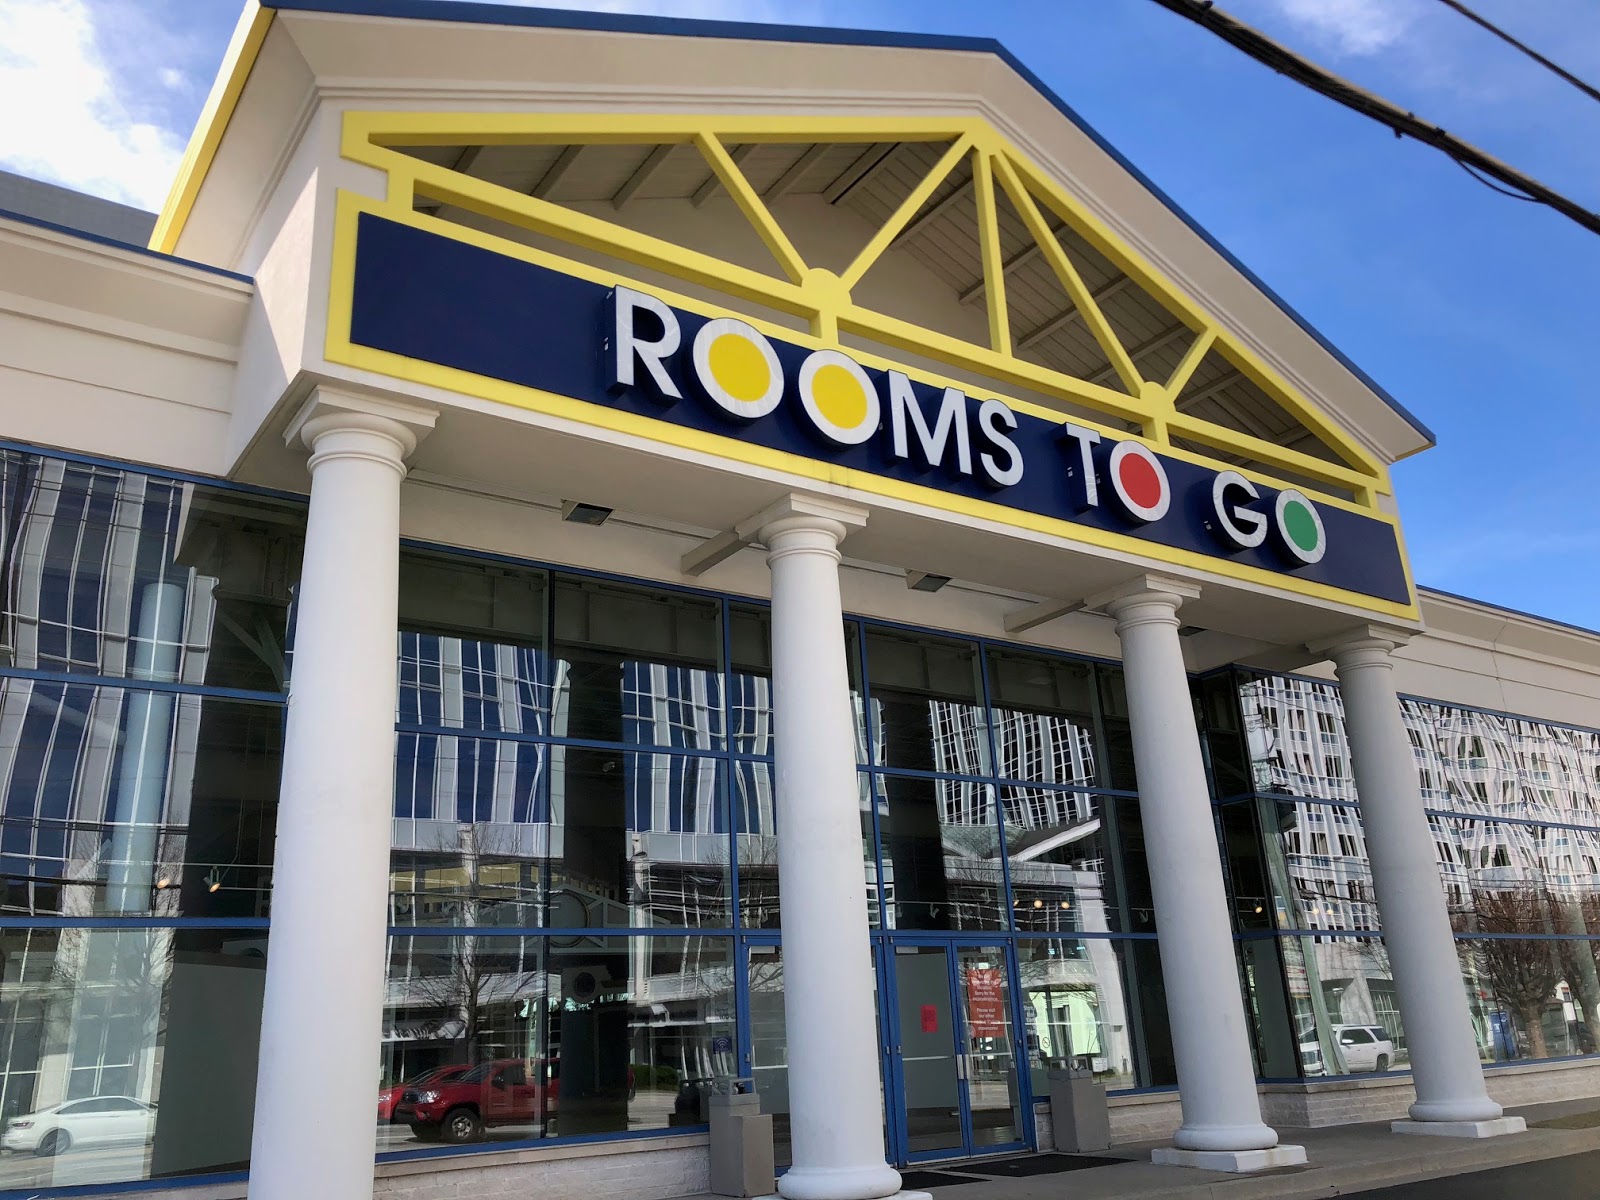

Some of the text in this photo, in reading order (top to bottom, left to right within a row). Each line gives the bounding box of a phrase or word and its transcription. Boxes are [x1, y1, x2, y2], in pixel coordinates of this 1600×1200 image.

[615, 284, 1326, 564] ROOMS TO GO
